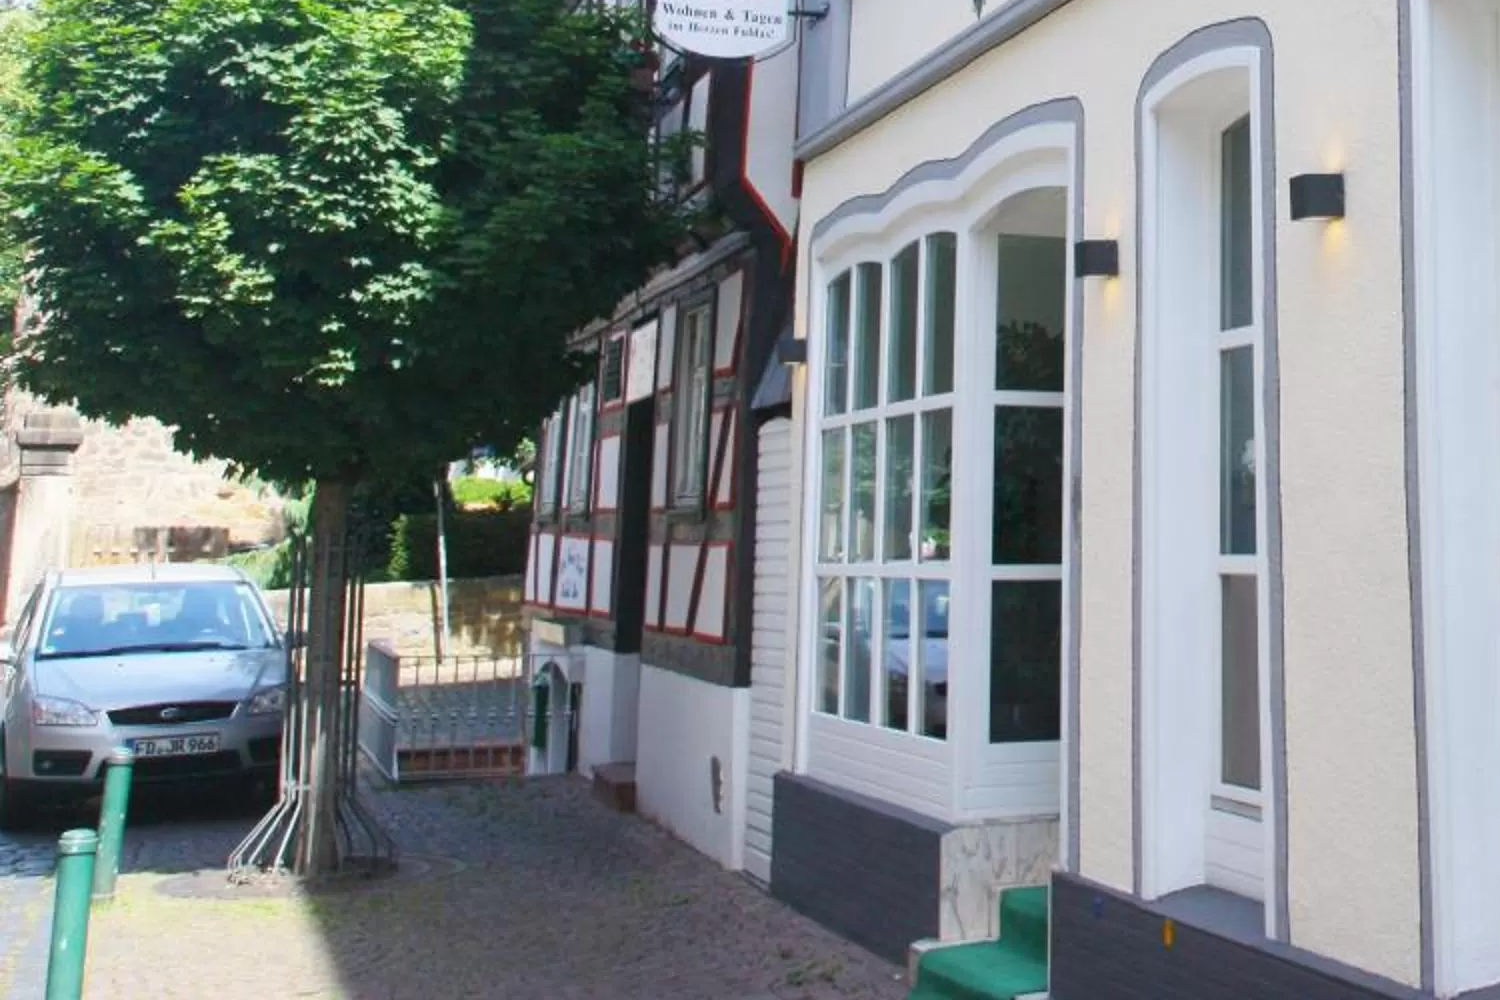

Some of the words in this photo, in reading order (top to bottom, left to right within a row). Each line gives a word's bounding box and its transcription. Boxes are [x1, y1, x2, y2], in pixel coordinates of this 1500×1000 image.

[663, 2, 718, 20] Wohnen
[723, 8, 735, 21] &
[741, 9, 783, 25] Tagen
